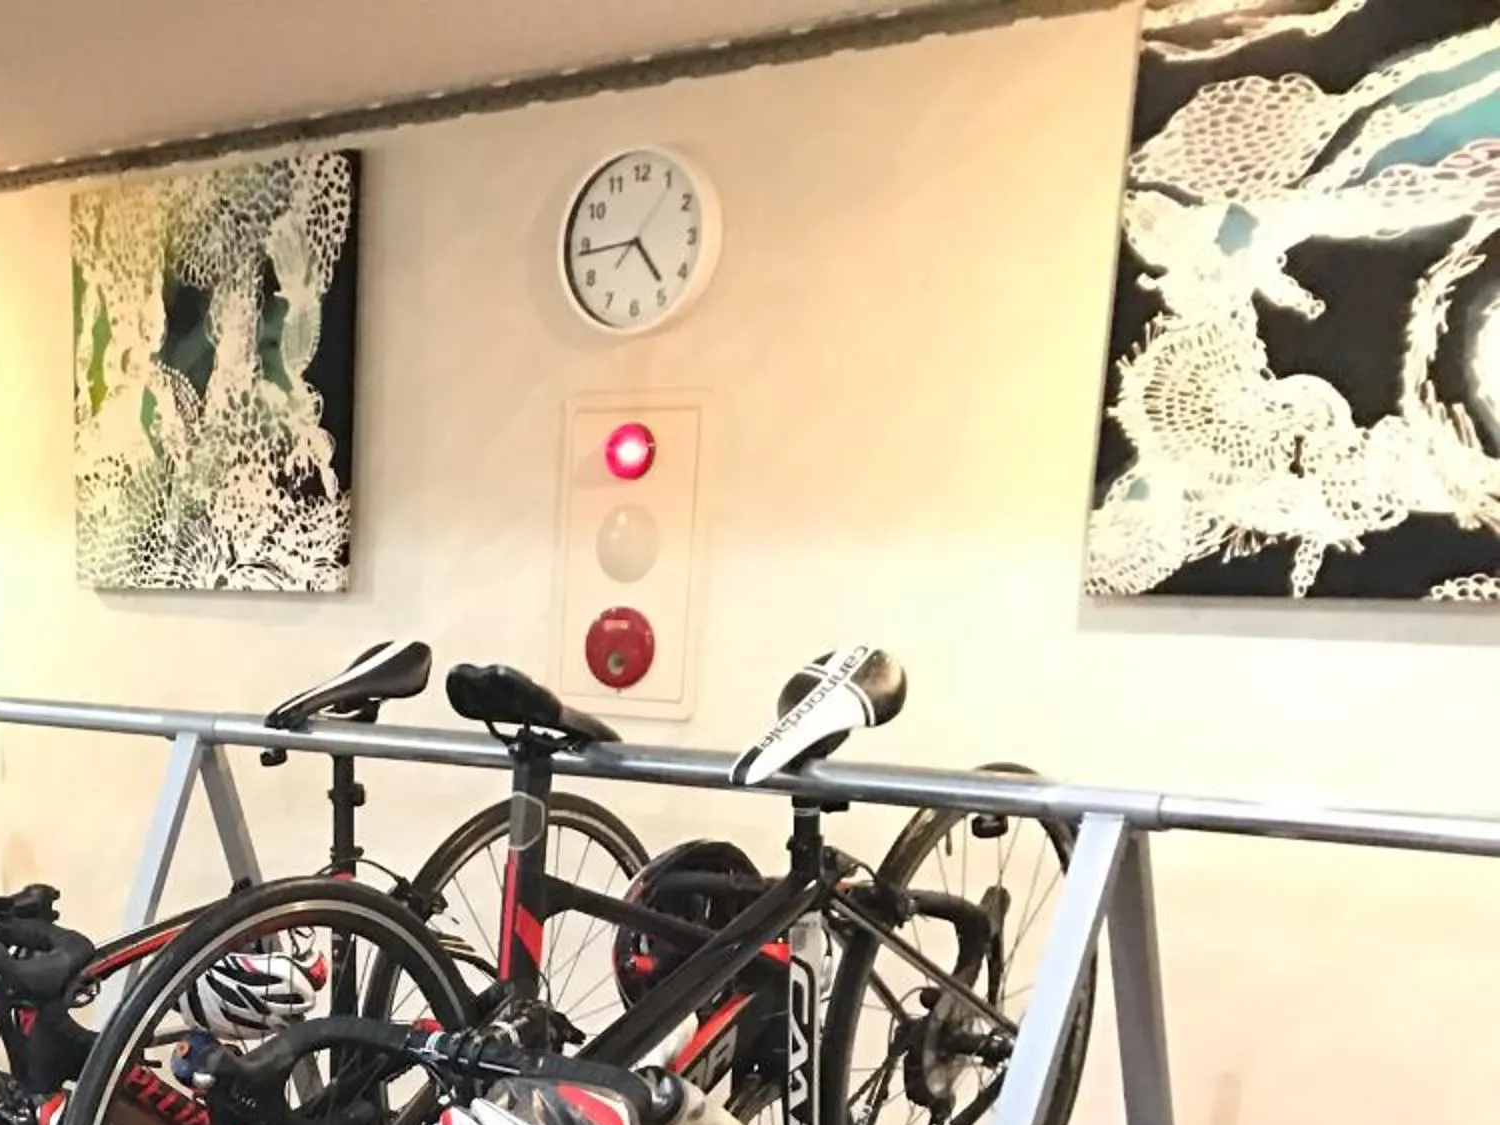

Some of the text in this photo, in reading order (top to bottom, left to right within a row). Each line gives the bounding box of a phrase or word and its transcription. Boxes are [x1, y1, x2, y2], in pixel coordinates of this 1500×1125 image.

[633, 164, 652, 182] 12
[609, 176, 624, 193] 11
[589, 202, 606, 220] 10
[680, 193, 693, 212] 2
[687, 227, 698, 246] 3
[586, 269, 596, 287] 8
[677, 262, 688, 281] 4
[605, 291, 615, 309] 7
[656, 289, 667, 308] 5
[629, 300, 640, 318] 6
[759, 644, 869, 750] cannondale
